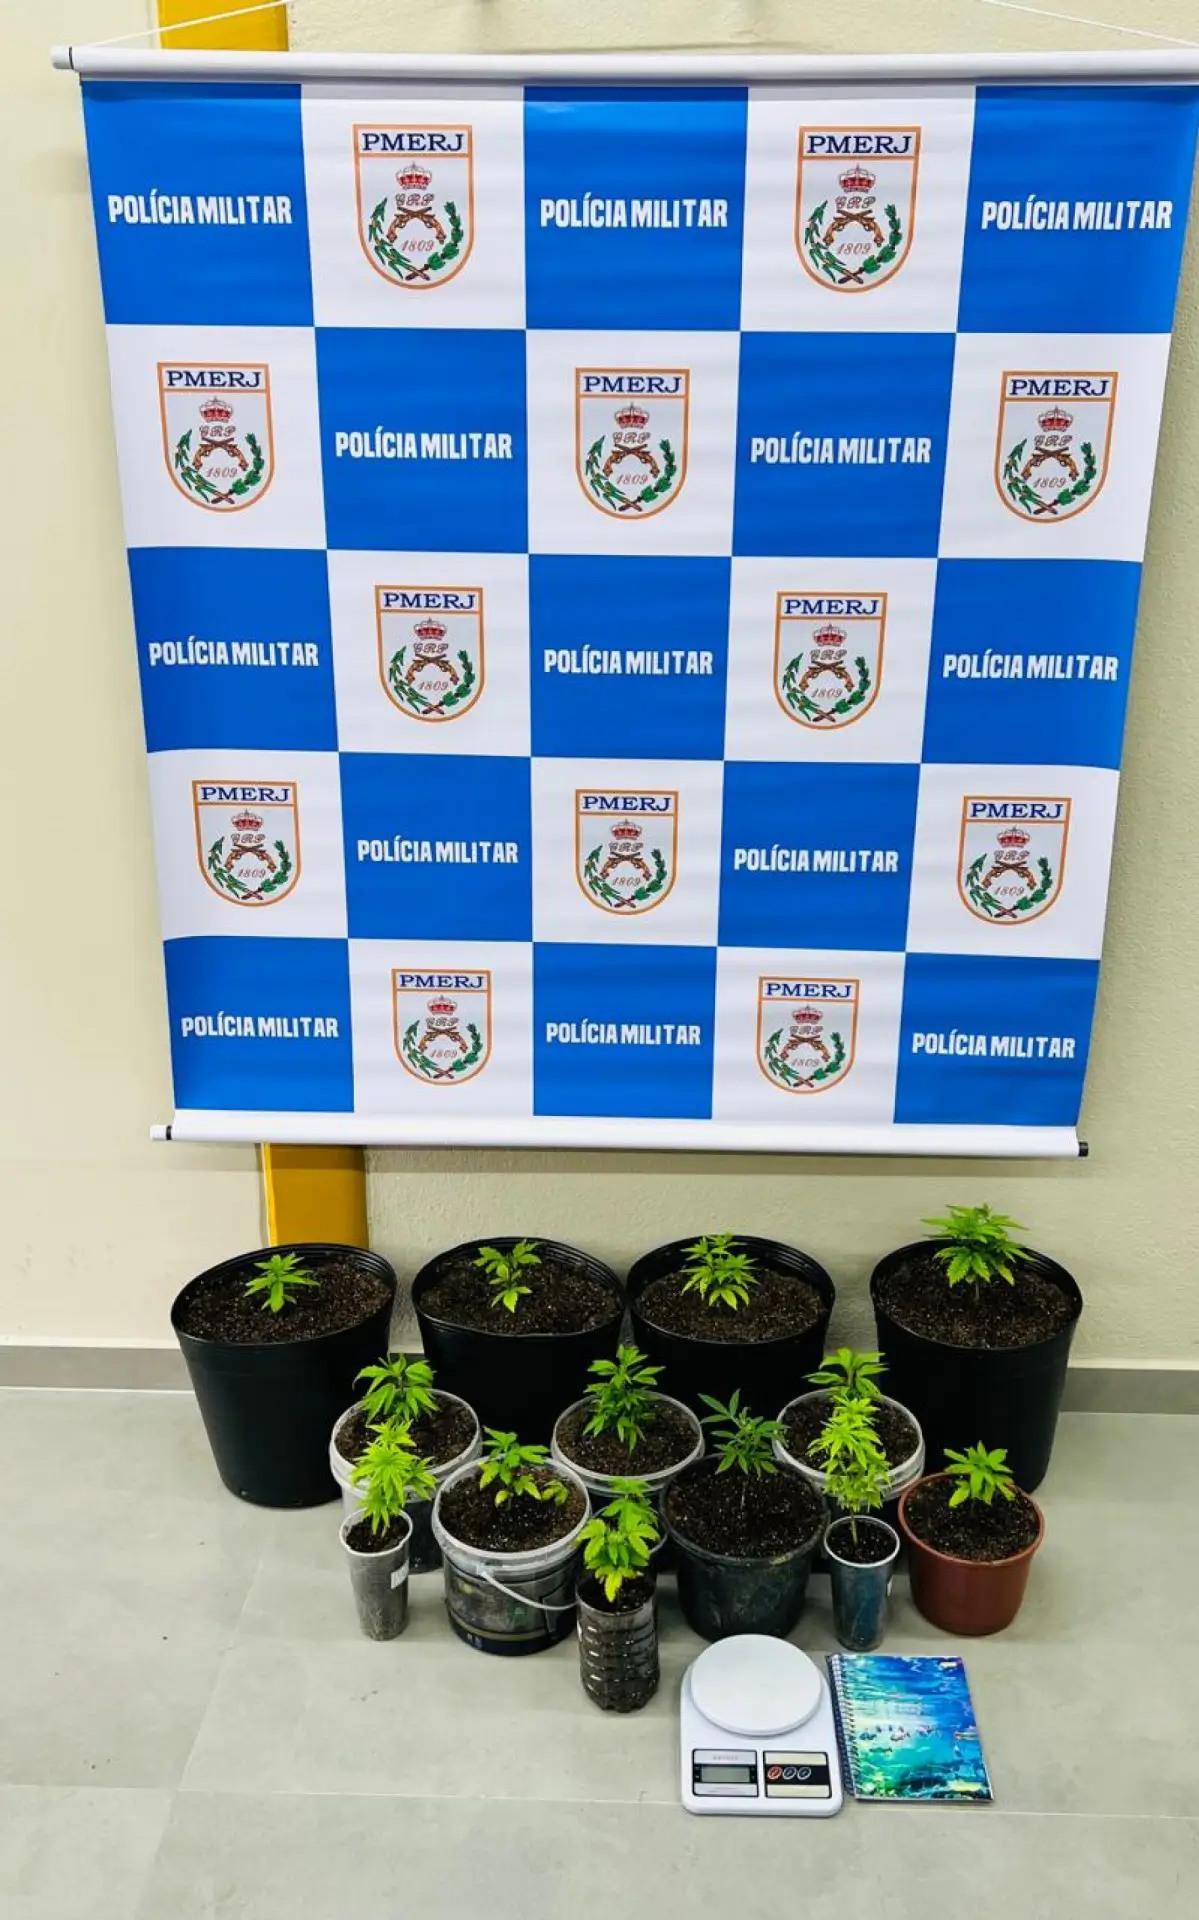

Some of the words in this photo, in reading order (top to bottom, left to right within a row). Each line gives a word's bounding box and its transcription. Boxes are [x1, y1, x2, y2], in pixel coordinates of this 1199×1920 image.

[361, 133, 464, 152] PMERJ
[807, 135, 913, 154] PMERJ
[108, 189, 194, 224] POLÍCIA
[197, 196, 291, 224] MILITAR
[541, 192, 627, 227] POLÍCIA
[631, 200, 727, 227] MILITAR
[982, 195, 1069, 229] POLÍCIA
[1073, 201, 1172, 229] MILITAR
[401, 240, 434, 252] 1809
[837, 243, 871, 254] 1809
[166, 370, 261, 388] PMERJ
[583, 375, 682, 394] PMERJ
[1009, 378, 1110, 397] PMERJ
[336, 426, 417, 458] POLÍCIA
[421, 433, 511, 459] MILITAR
[751, 432, 833, 463] POLÍCIA
[838, 438, 931, 463] MILITAR
[206, 467, 237, 478] 1809
[617, 476, 648, 485] 1809
[1033, 478, 1066, 488] 1809
[383, 592, 475, 610] PMERJ
[784, 599, 879, 615] PMERJ
[149, 636, 228, 665] POLÍCIA
[232, 642, 318, 666] MILITAR
[545, 645, 622, 673] POLÍCIA
[626, 651, 712, 674] MILITAR
[943, 649, 1022, 678] POLÍCIA
[1027, 655, 1118, 680] MILITAR
[419, 680, 448, 691] 1809
[811, 688, 842, 698] 1809
[200, 786, 289, 802] PMERJ
[582, 795, 671, 812] PMERJ
[970, 802, 1063, 819] PMERJ
[358, 836, 432, 861] POLÍCIA
[436, 842, 517, 863] MILITAR
[735, 845, 809, 871] POLÍCIA
[814, 851, 898, 872] MILITAR
[237, 868, 266, 878] 1809
[612, 876, 641, 886] 1809
[994, 885, 1025, 896] 1809
[399, 974, 484, 989] PMERJ
[766, 982, 852, 998] PMERJ
[182, 1011, 255, 1036] POLÍCIA
[258, 1017, 338, 1037] MILITAR
[547, 1019, 617, 1043] POLÍCIA
[621, 1025, 700, 1044] MILITAR
[913, 1030, 986, 1055] POLÍCIA
[991, 1036, 1075, 1057] MILITAR
[430, 1049, 457, 1059] 1809
[792, 1058, 820, 1067] 1809
